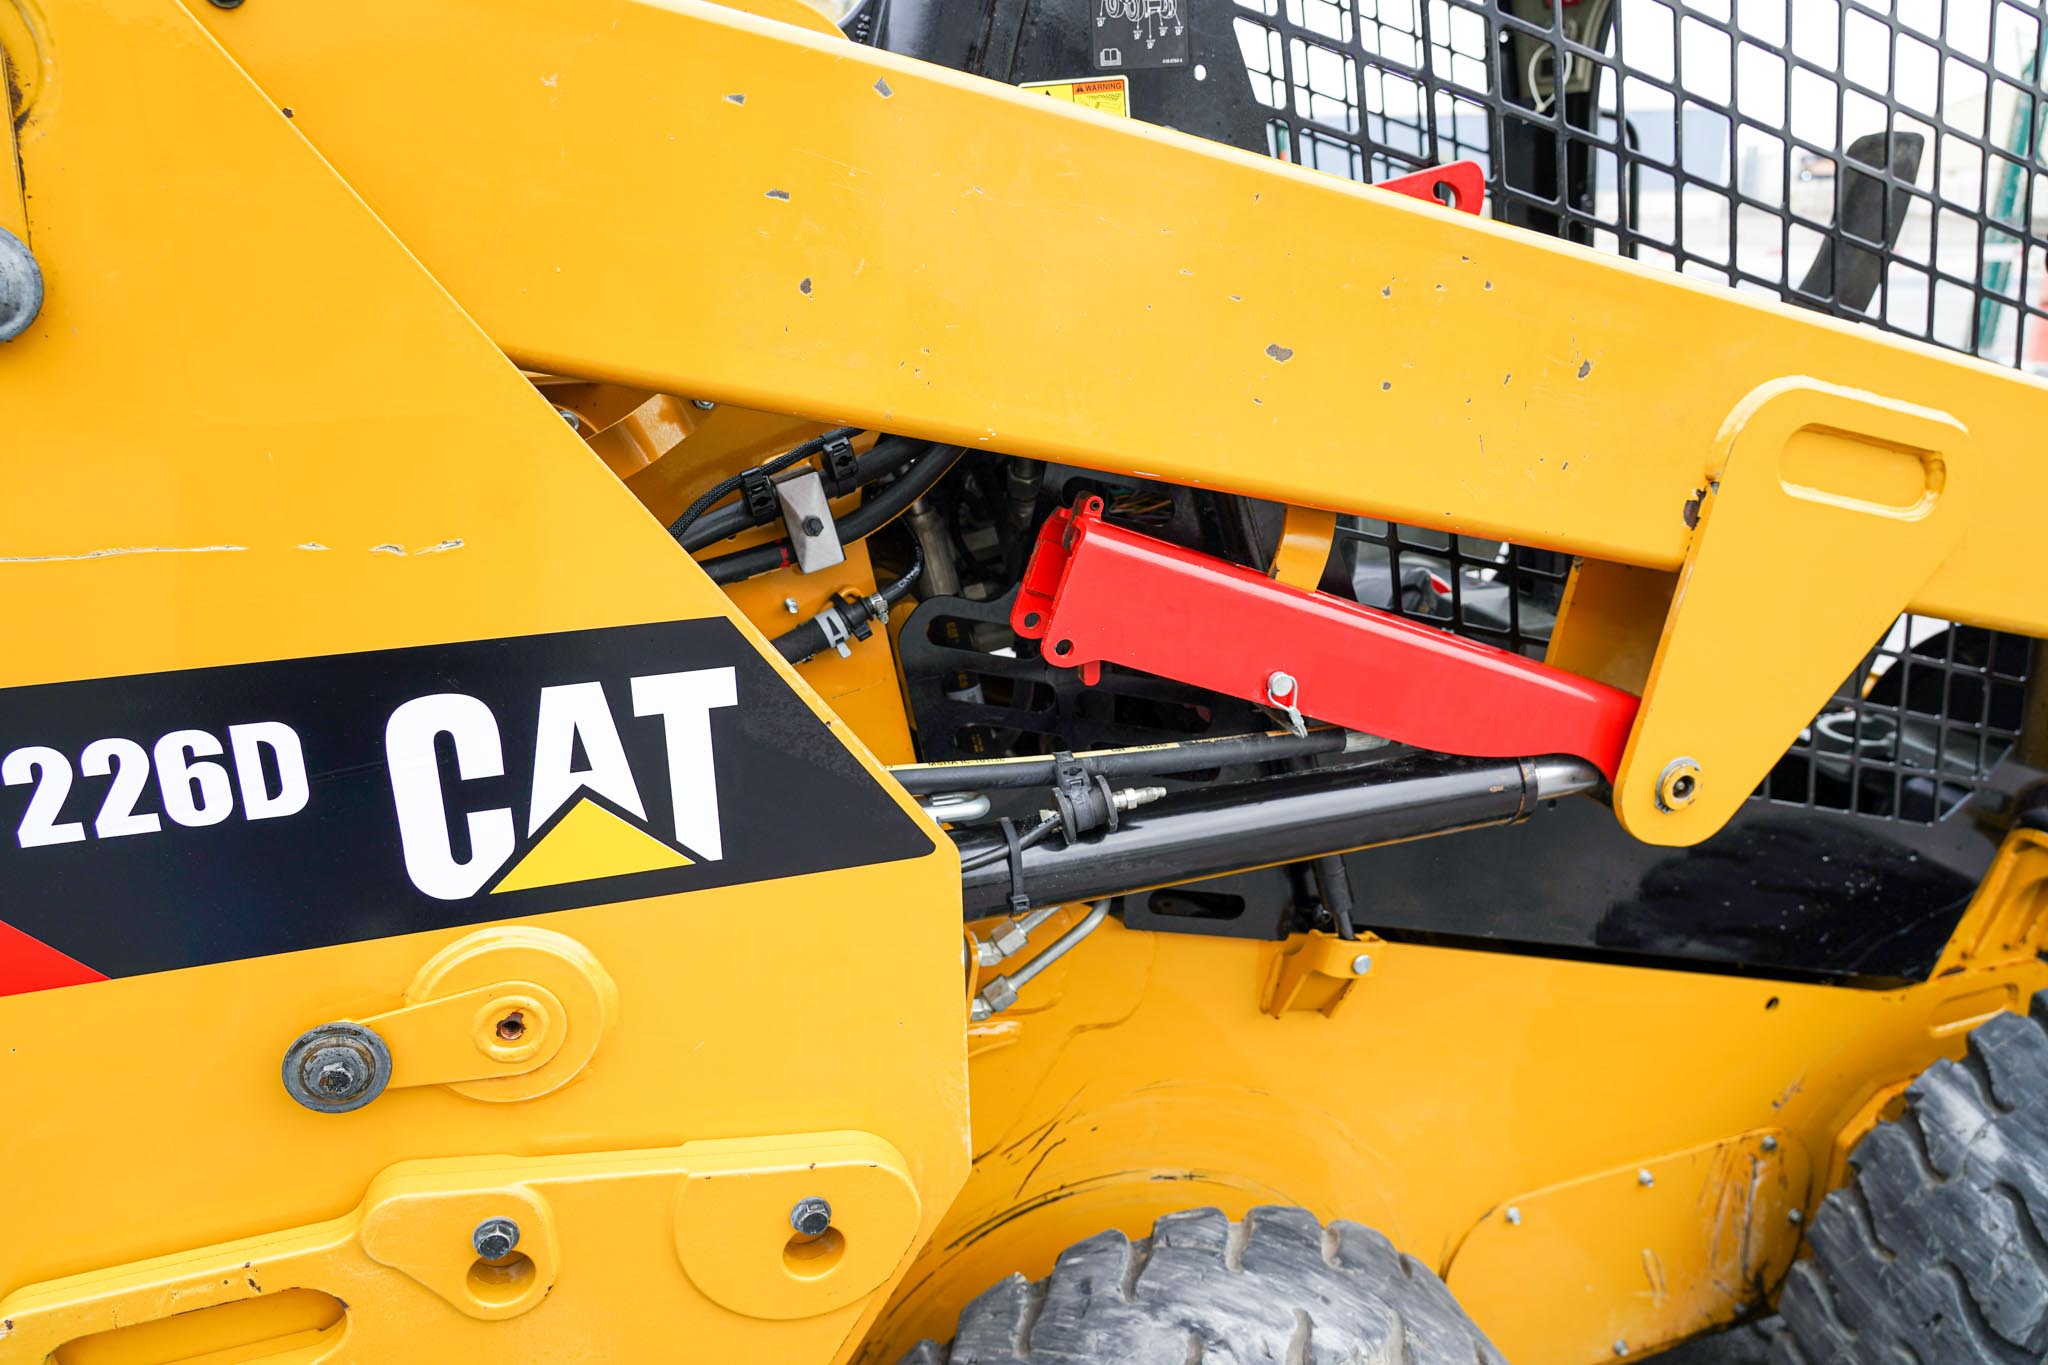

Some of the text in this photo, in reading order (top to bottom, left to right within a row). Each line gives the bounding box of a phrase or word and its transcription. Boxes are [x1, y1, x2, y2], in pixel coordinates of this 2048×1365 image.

[1085, 82, 1122, 92] WARNING
[1, 721, 310, 848] 226D
[385, 666, 738, 900] CAT
